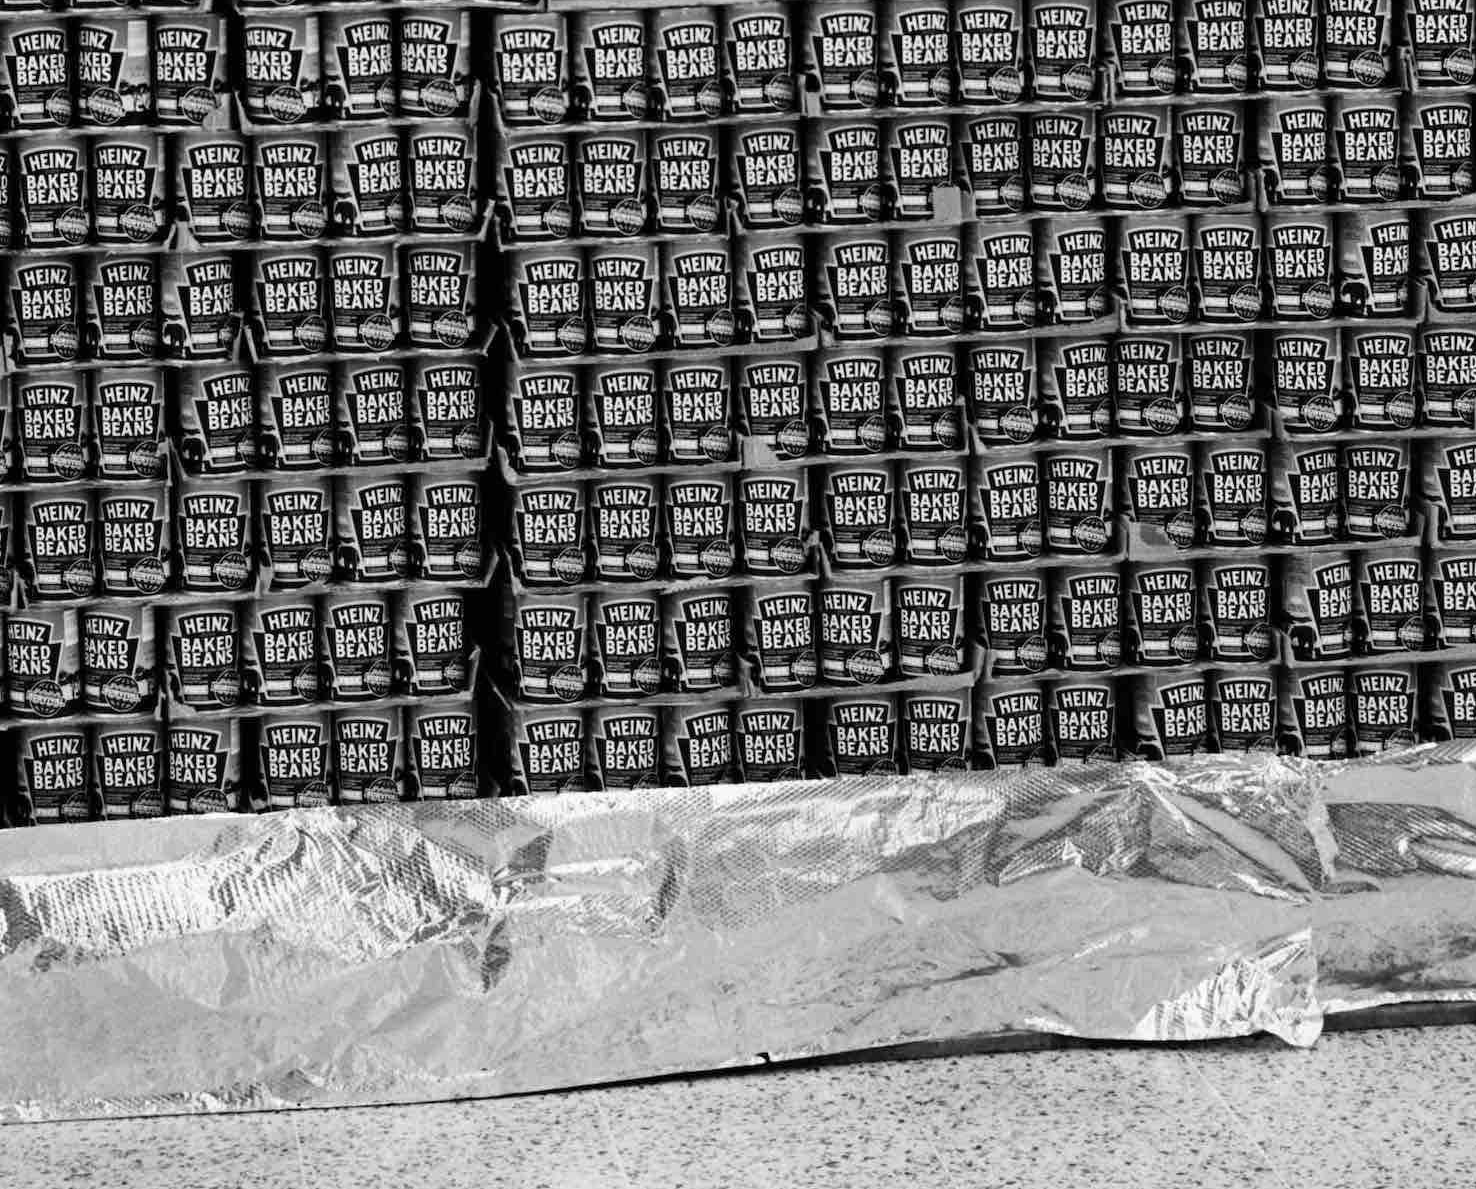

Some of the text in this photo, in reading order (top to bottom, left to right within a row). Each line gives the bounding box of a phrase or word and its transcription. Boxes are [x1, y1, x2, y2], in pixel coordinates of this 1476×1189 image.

[1264, 18, 1313, 33] BAKED
[1264, 33, 1311, 47] BEANS
[418, 138, 462, 157] HEINZ
[748, 135, 791, 154] HEINZ
[29, 152, 74, 171] HEINZ
[414, 159, 465, 176] BAKED
[746, 155, 795, 171] BAKED
[28, 172, 78, 189] BAKED
[414, 175, 464, 190] BEANS
[747, 169, 795, 186] BEANS
[29, 188, 78, 205] BEANS
[1207, 229, 1250, 248] HEINZ
[1203, 251, 1253, 267] BAKED
[268, 262, 314, 281] HEINZ
[1203, 265, 1252, 280] BEANS
[266, 282, 318, 298] BAKED
[267, 296, 318, 313] BEANS
[977, 352, 1019, 368] HEINZ
[753, 367, 796, 386] HEINZ
[975, 372, 1023, 386] BAKED
[751, 387, 800, 403] BAKED
[975, 386, 1024, 401] BEANS
[752, 401, 800, 418] BEANS
[273, 494, 319, 513] HEINZ
[37, 504, 82, 523] HEINZ
[271, 514, 323, 530] BAKED
[36, 524, 86, 541] BAKED
[272, 528, 323, 545] BEANS
[37, 540, 86, 557] BEANS
[1360, 676, 1403, 692] HEINZ
[1358, 696, 1408, 710] BAKED
[748, 714, 790, 731] HEINZ
[1358, 710, 1409, 724] BEANS
[425, 718, 468, 737] HEINZ
[421, 738, 471, 754] BAKED
[746, 733, 794, 749] BAKED
[421, 752, 470, 769] BEANS
[746, 747, 795, 764] BEANS
